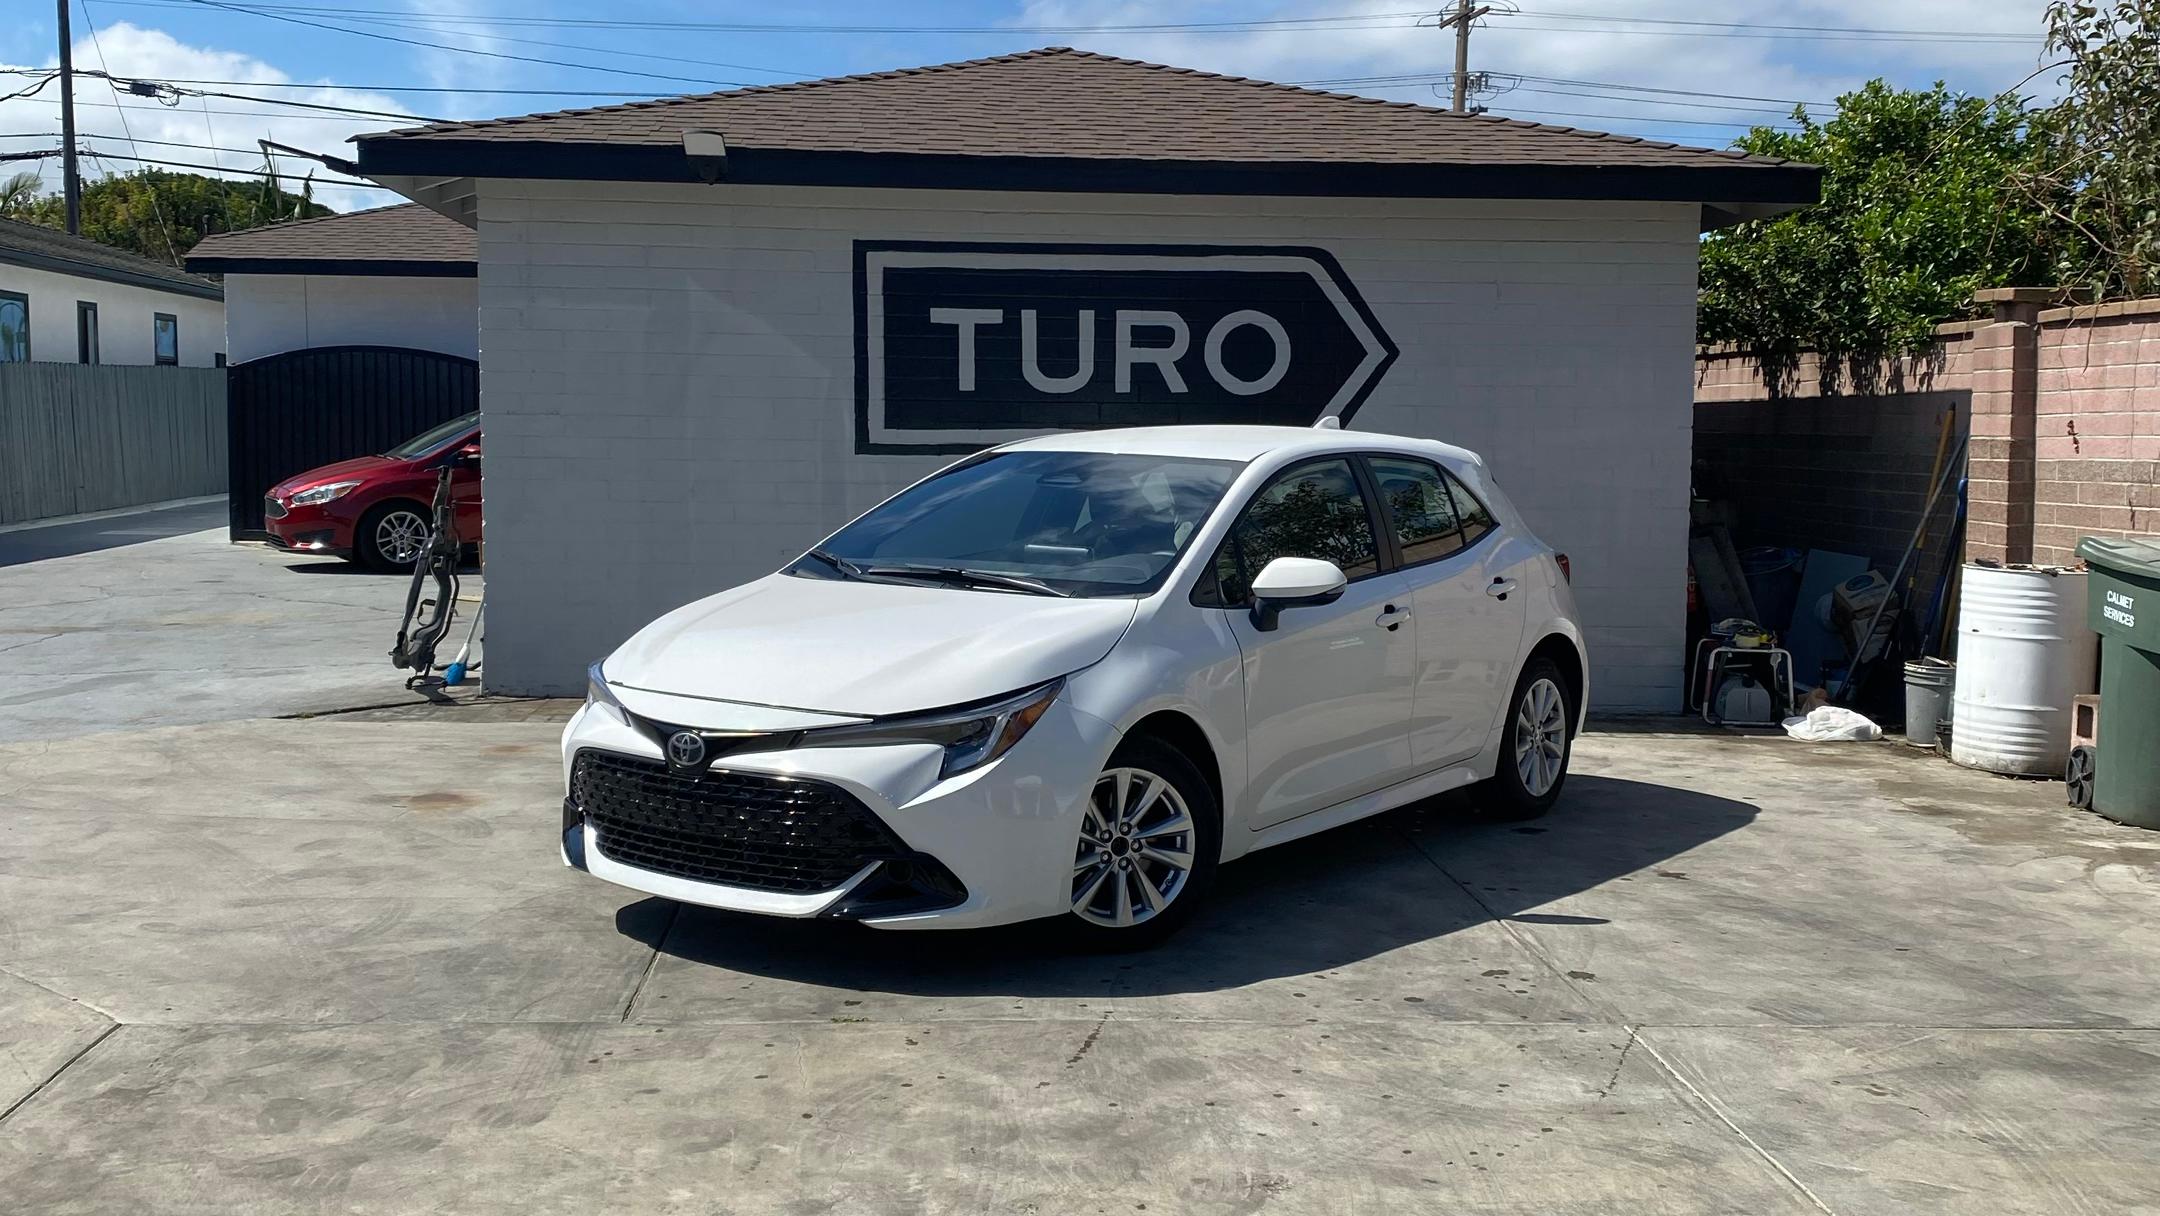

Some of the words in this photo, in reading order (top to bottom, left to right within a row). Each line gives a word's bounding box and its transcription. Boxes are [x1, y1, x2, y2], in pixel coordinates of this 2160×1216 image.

[930, 307, 1291, 395] TURO
[2106, 590, 2134, 610] CALMET
[2103, 605, 2135, 628] SERVICES
